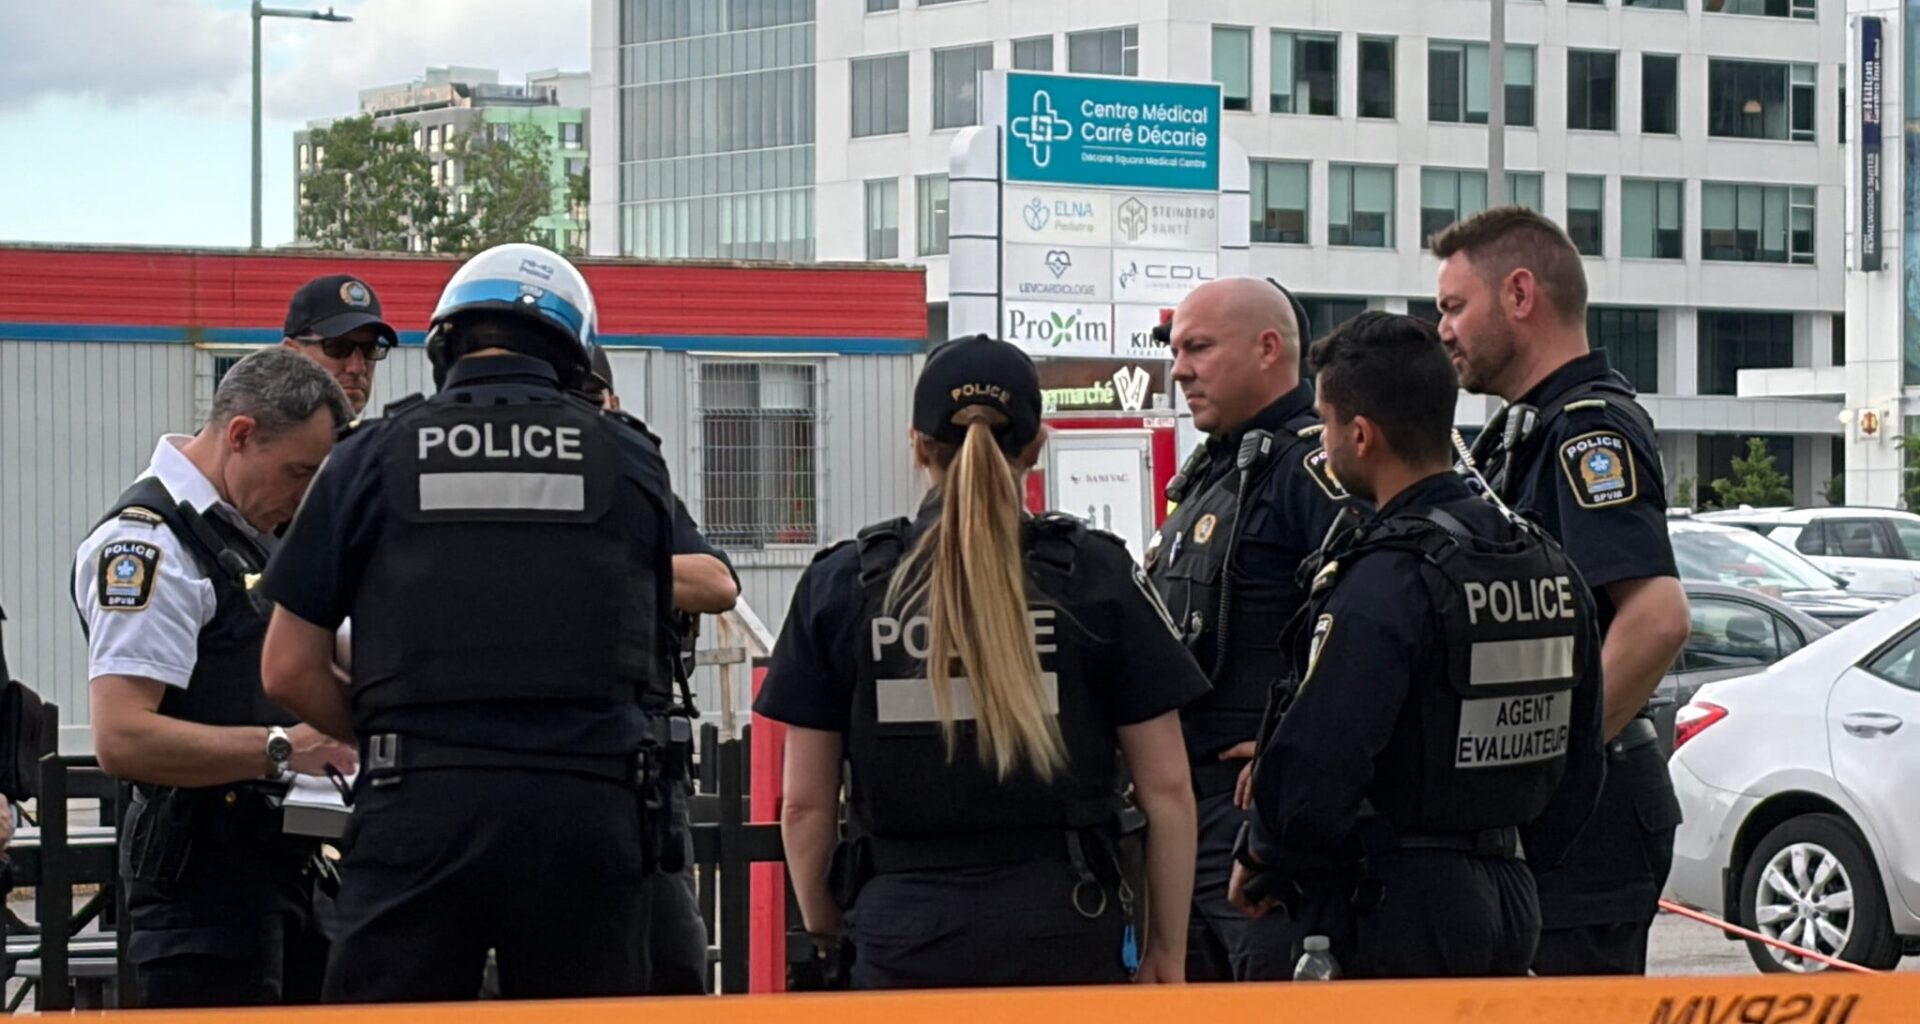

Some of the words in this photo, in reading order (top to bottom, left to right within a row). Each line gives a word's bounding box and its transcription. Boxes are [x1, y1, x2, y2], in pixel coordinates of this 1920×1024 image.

[1863, 60, 1874, 110] Hilton
[1081, 99, 1138, 119] Centre
[1142, 103, 1208, 124] Médical
[1081, 121, 1134, 143] Carré
[1137, 125, 1207, 148] Décarie
[1115, 153, 1144, 166] Square
[1055, 200, 1094, 217] ELNA
[1152, 205, 1215, 220] STEINBERG
[1152, 220, 1190, 235] SANTÉ
[1145, 264, 1216, 280] CDL
[1019, 282, 1095, 296] LEVCARDIOLOGIE
[951, 383, 1011, 403] POLICE
[418, 422, 584, 460] POLICE
[1566, 436, 1623, 459] POLICE
[1593, 490, 1623, 502] SPVM
[104, 543, 157, 560] POLICE
[1463, 575, 1576, 625] POLICE
[871, 609, 1058, 661] POE
[1496, 694, 1555, 727] AGENT
